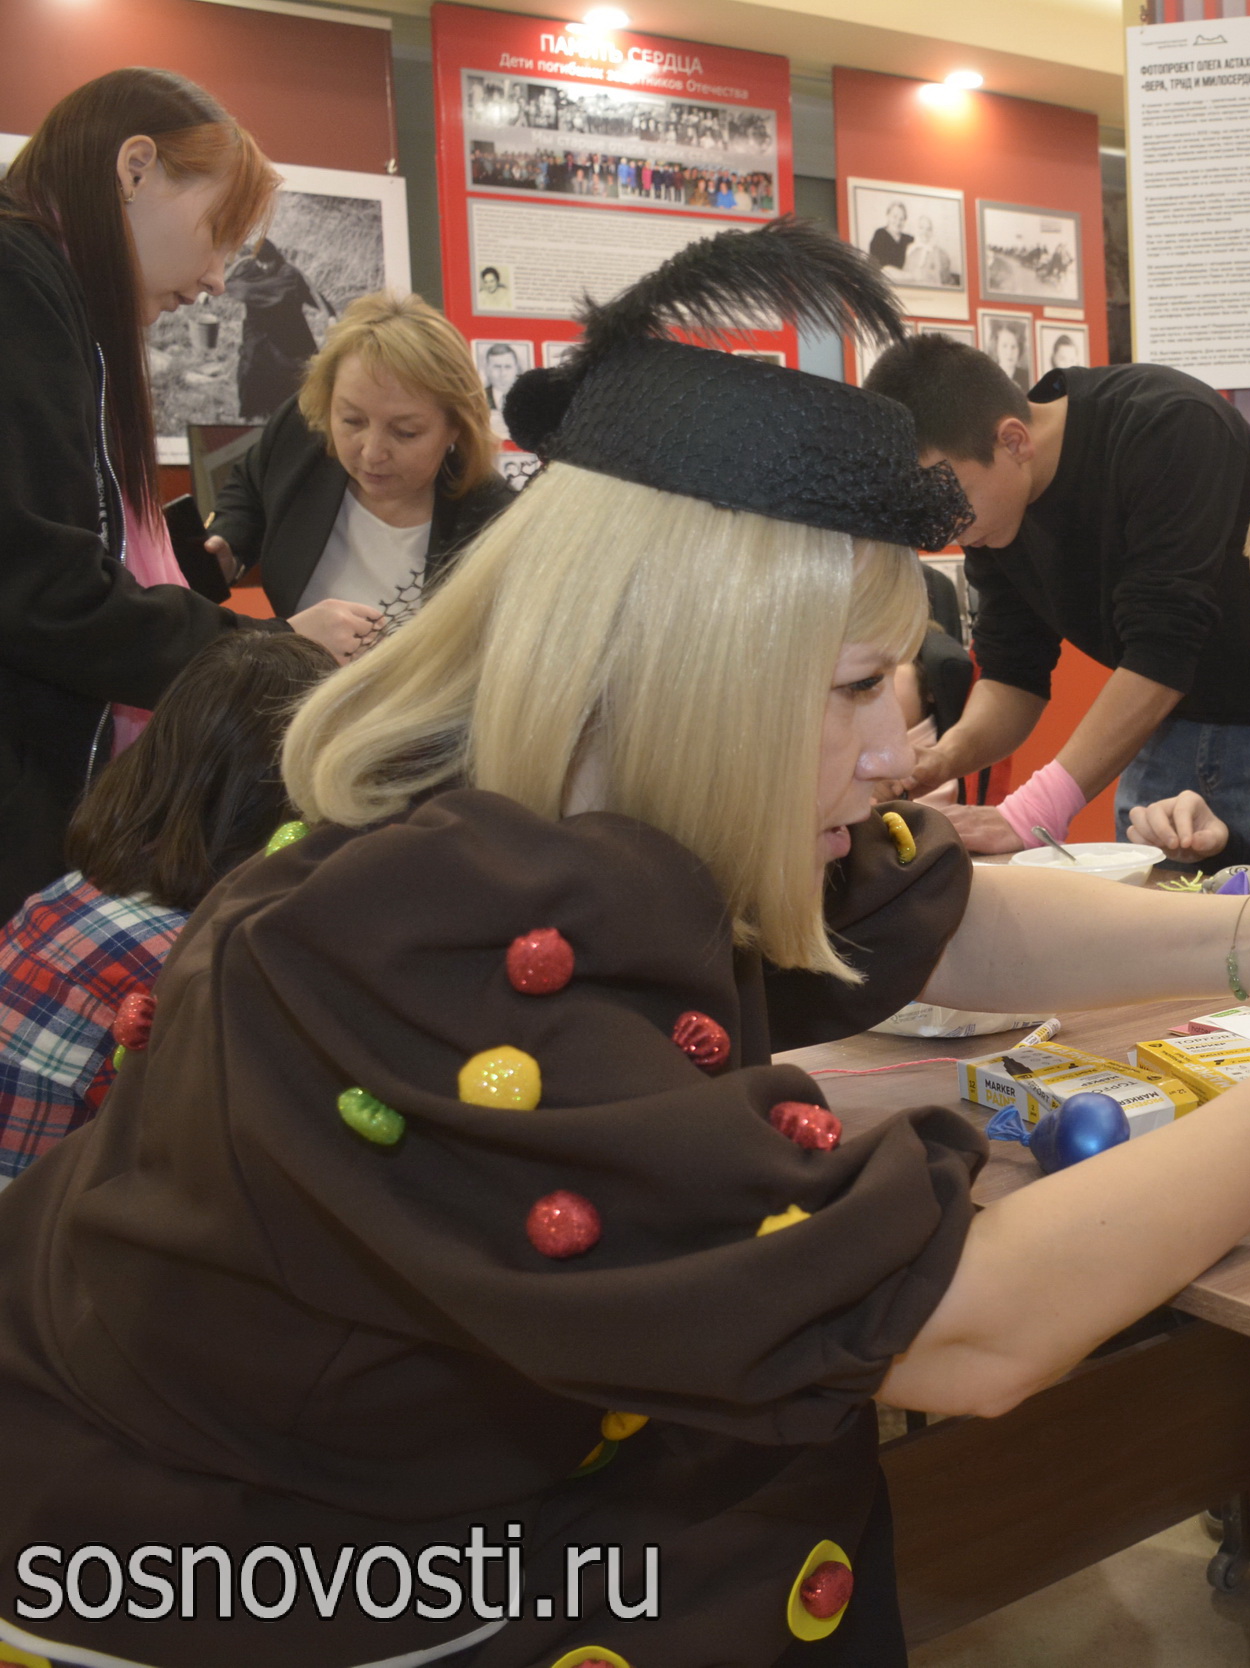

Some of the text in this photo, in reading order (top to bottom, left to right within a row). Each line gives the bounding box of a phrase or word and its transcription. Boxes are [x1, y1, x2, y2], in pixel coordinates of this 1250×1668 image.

[627, 47, 703, 75] СЕРДЦА
[1140, 61, 1195, 75] ФОТОПРОЕКТ
[1196, 59, 1221, 72] ОЛЕГА
[499, 53, 534, 69] Дети
[686, 78, 749, 99] Отечества
[1170, 77, 1193, 91] ТРУД
[1194, 77, 1201, 88] И
[968, 1080, 976, 1088] 12
[985, 1079, 1016, 1097] MARKER
[1092, 1080, 1137, 1094] TOPFO
[985, 1089, 1017, 1107] PAINT
[1120, 1091, 1159, 1106] MARKER
